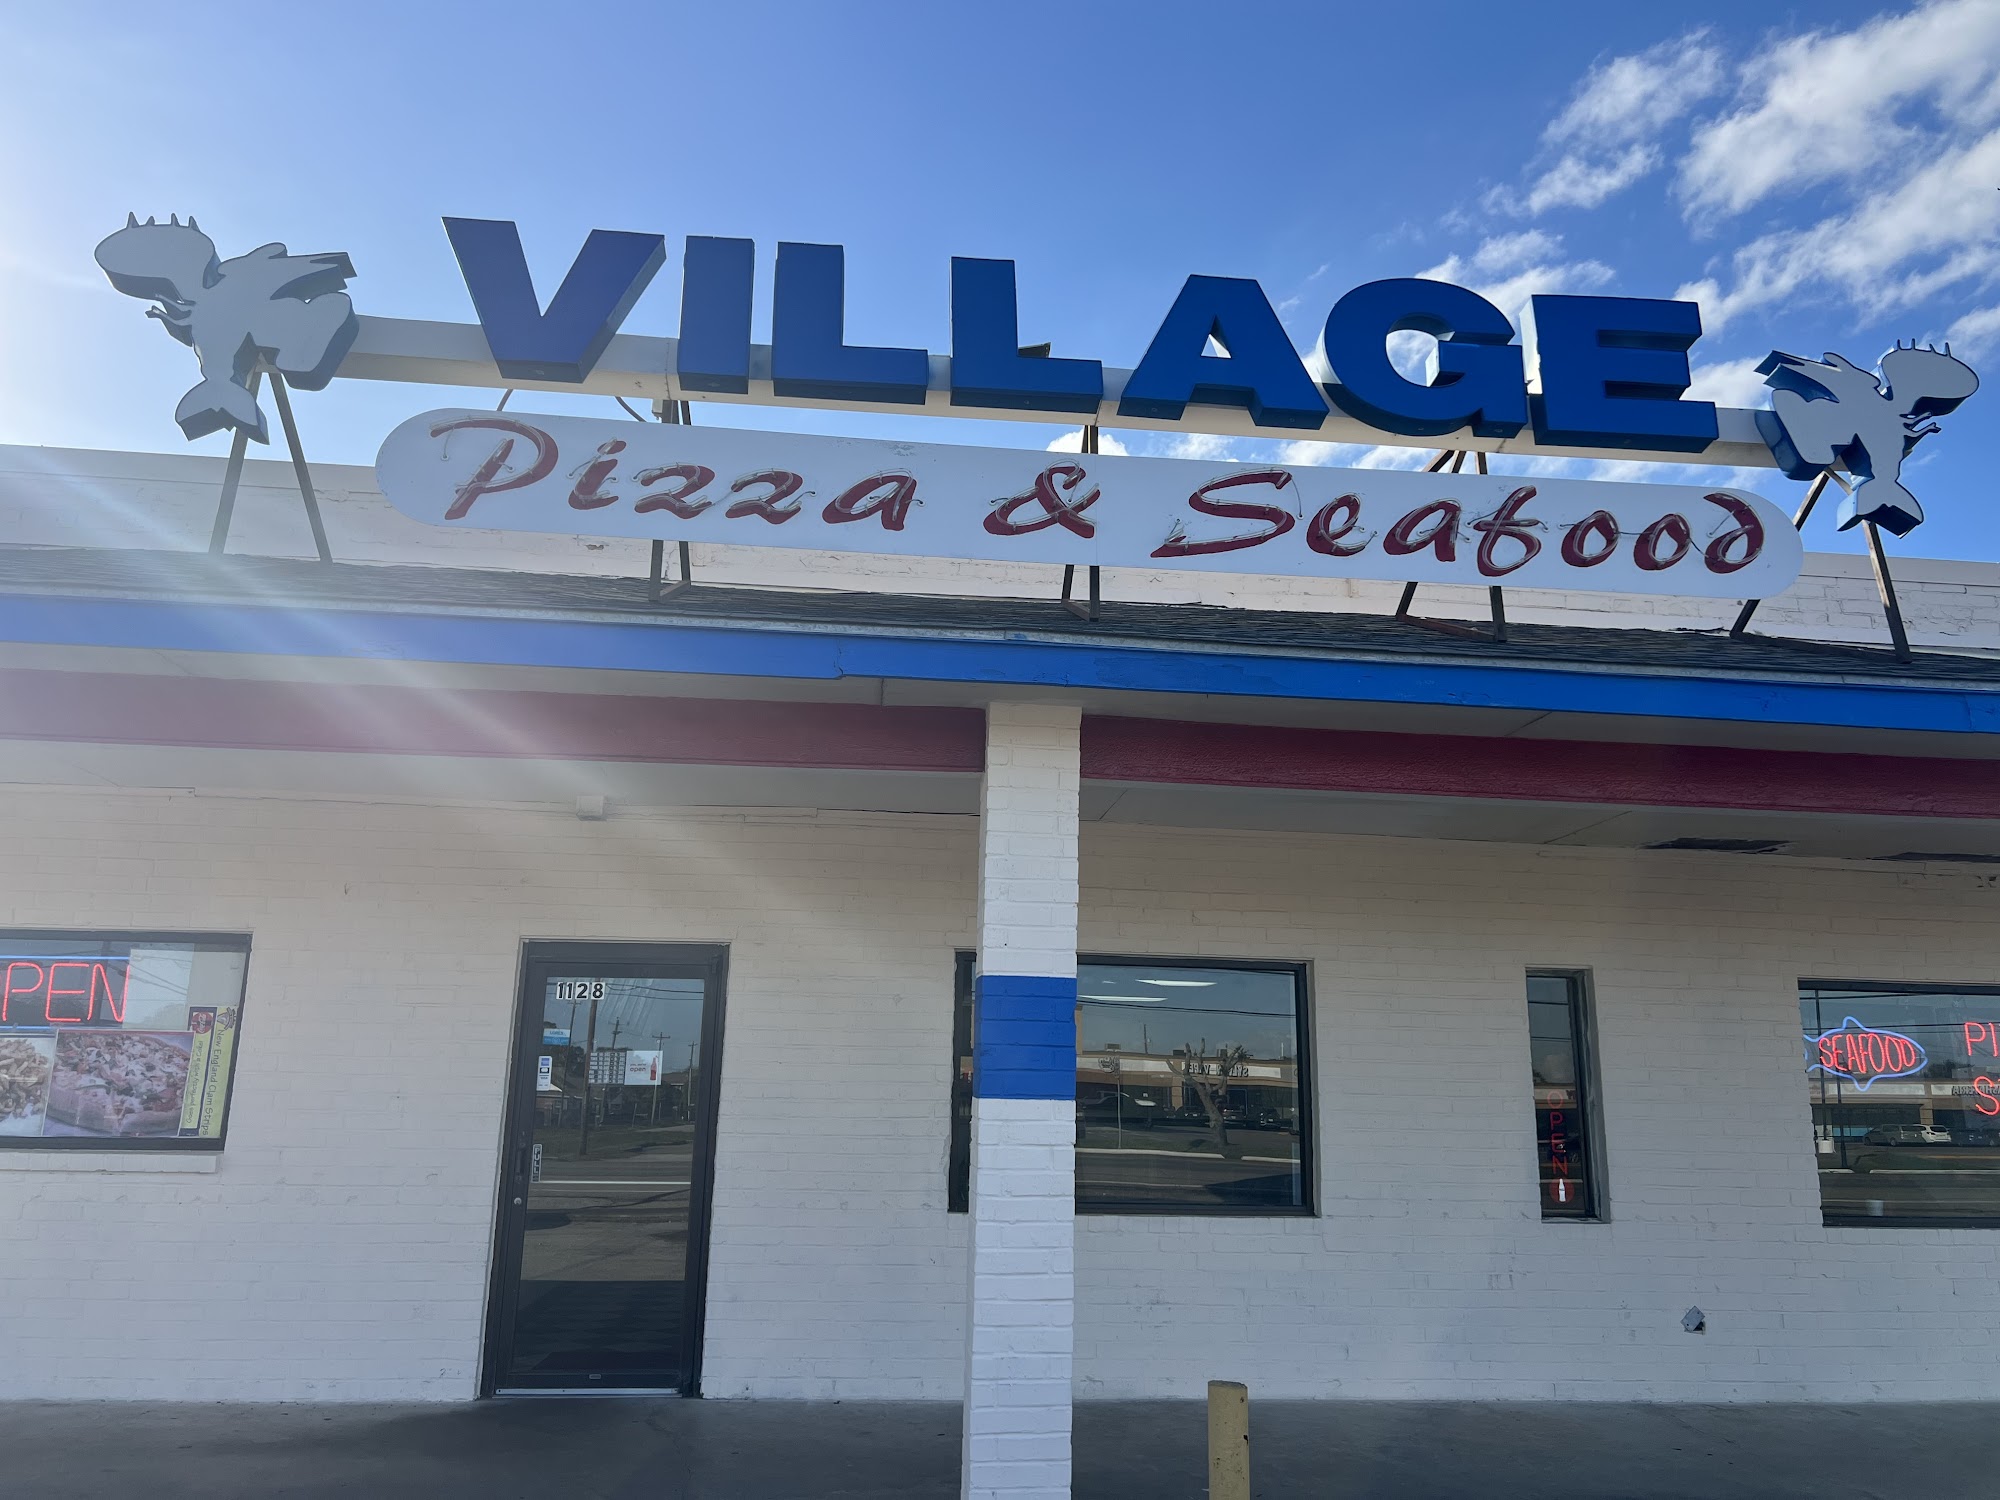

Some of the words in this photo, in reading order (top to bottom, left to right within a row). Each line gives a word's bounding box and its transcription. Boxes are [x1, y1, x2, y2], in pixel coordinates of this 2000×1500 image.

[441, 216, 1718, 453] VILLAGE
[430, 416, 920, 532] Pizza
[983, 459, 1101, 539] &
[1150, 467, 1765, 577] Seafood
[0, 961, 130, 1022] PEN
[558, 982, 604, 999] 1128
[215, 1029, 225, 1047] New
[1818, 1032, 1915, 1074] SEAFOOD
[1964, 1022, 2000, 1057] PI
[210, 1050, 222, 1083] England
[206, 1085, 217, 1106] Clam
[1974, 1076, 2000, 1115] S
[201, 1107, 214, 1136] Strips
[1547, 1090, 1569, 1175] OPEN
[533, 1147, 541, 1174] PULL
